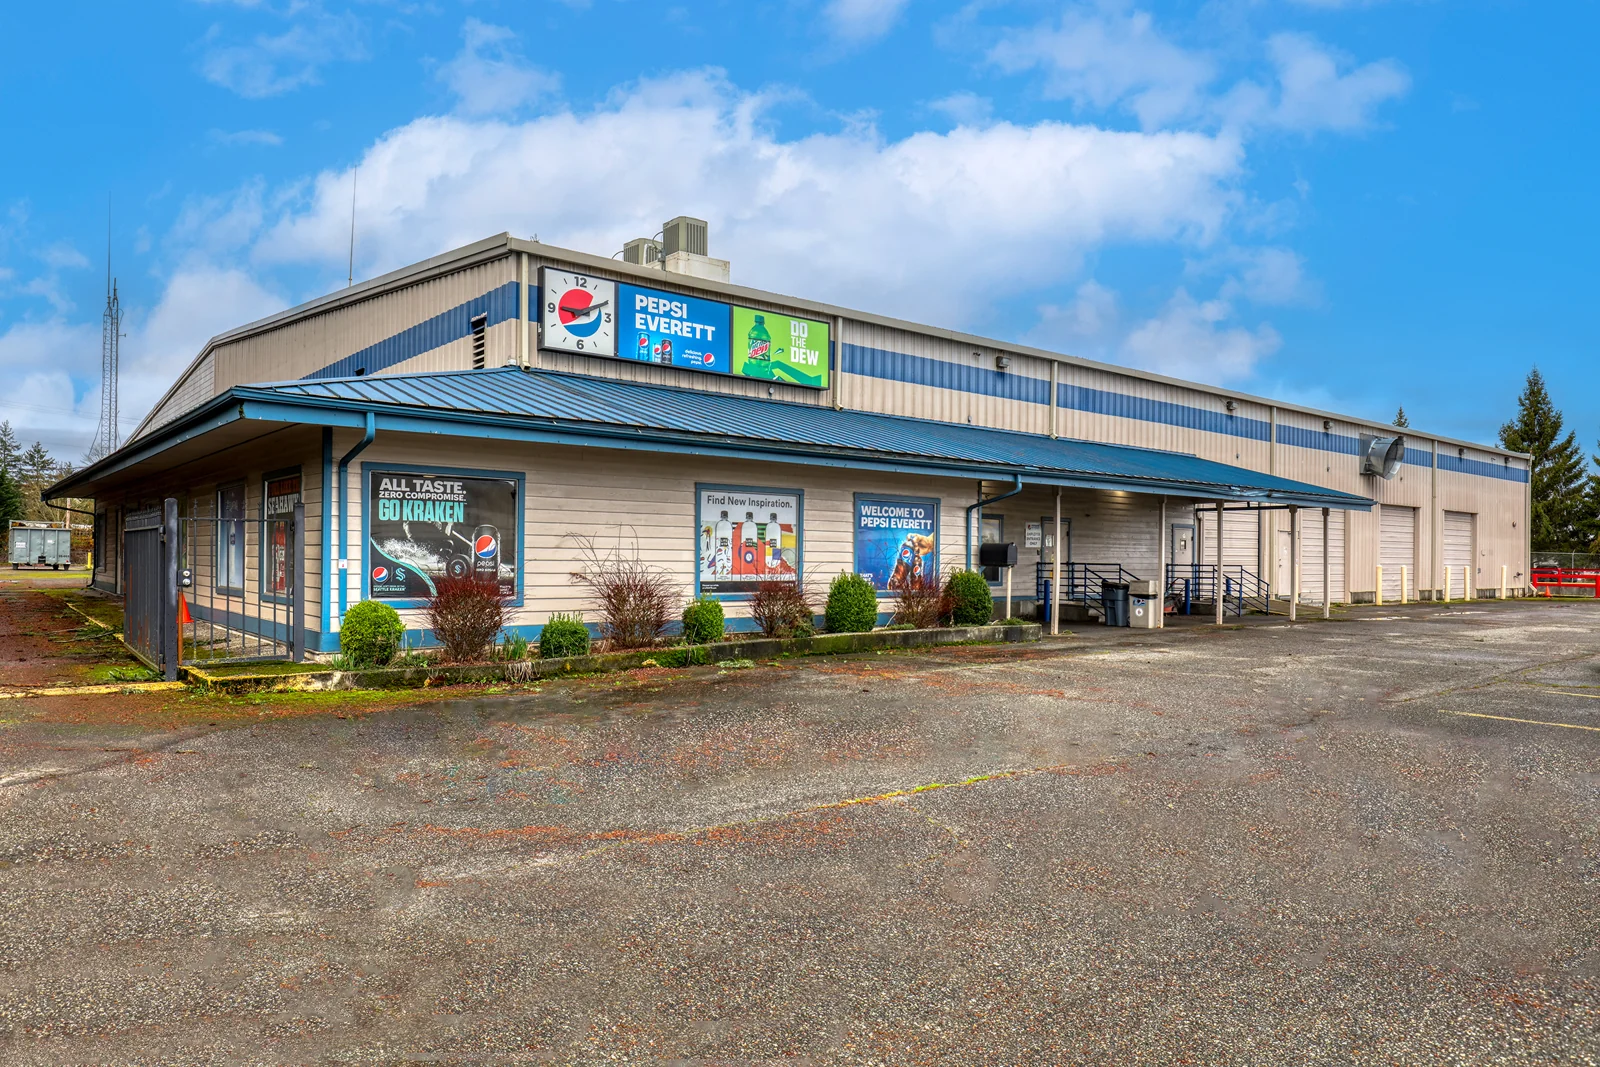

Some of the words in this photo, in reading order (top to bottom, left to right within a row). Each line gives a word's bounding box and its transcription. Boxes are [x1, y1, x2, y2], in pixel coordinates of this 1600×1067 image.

[574, 276, 587, 288] 12
[547, 302, 556, 313] 9
[635, 294, 687, 319] PEPSI
[604, 312, 612, 324] 3
[635, 313, 716, 341] EVERETT
[790, 320, 808, 338] DO
[576, 339, 585, 350] 6
[791, 336, 806, 349] THE
[790, 346, 819, 366] DEW
[380, 478, 410, 492] ALL
[413, 479, 467, 495] TASTE.
[379, 491, 403, 499] ZERO
[405, 492, 467, 501] COMPROMISE.
[707, 495, 726, 505] Find
[727, 496, 747, 506] New
[748, 498, 793, 508] Inspiration.
[379, 499, 400, 521] GO
[403, 500, 464, 523] KRAKEN
[861, 505, 910, 517] WELCOME
[911, 508, 924, 518] TO
[861, 517, 889, 527] PEPSI
[890, 518, 932, 529] EVERETT
